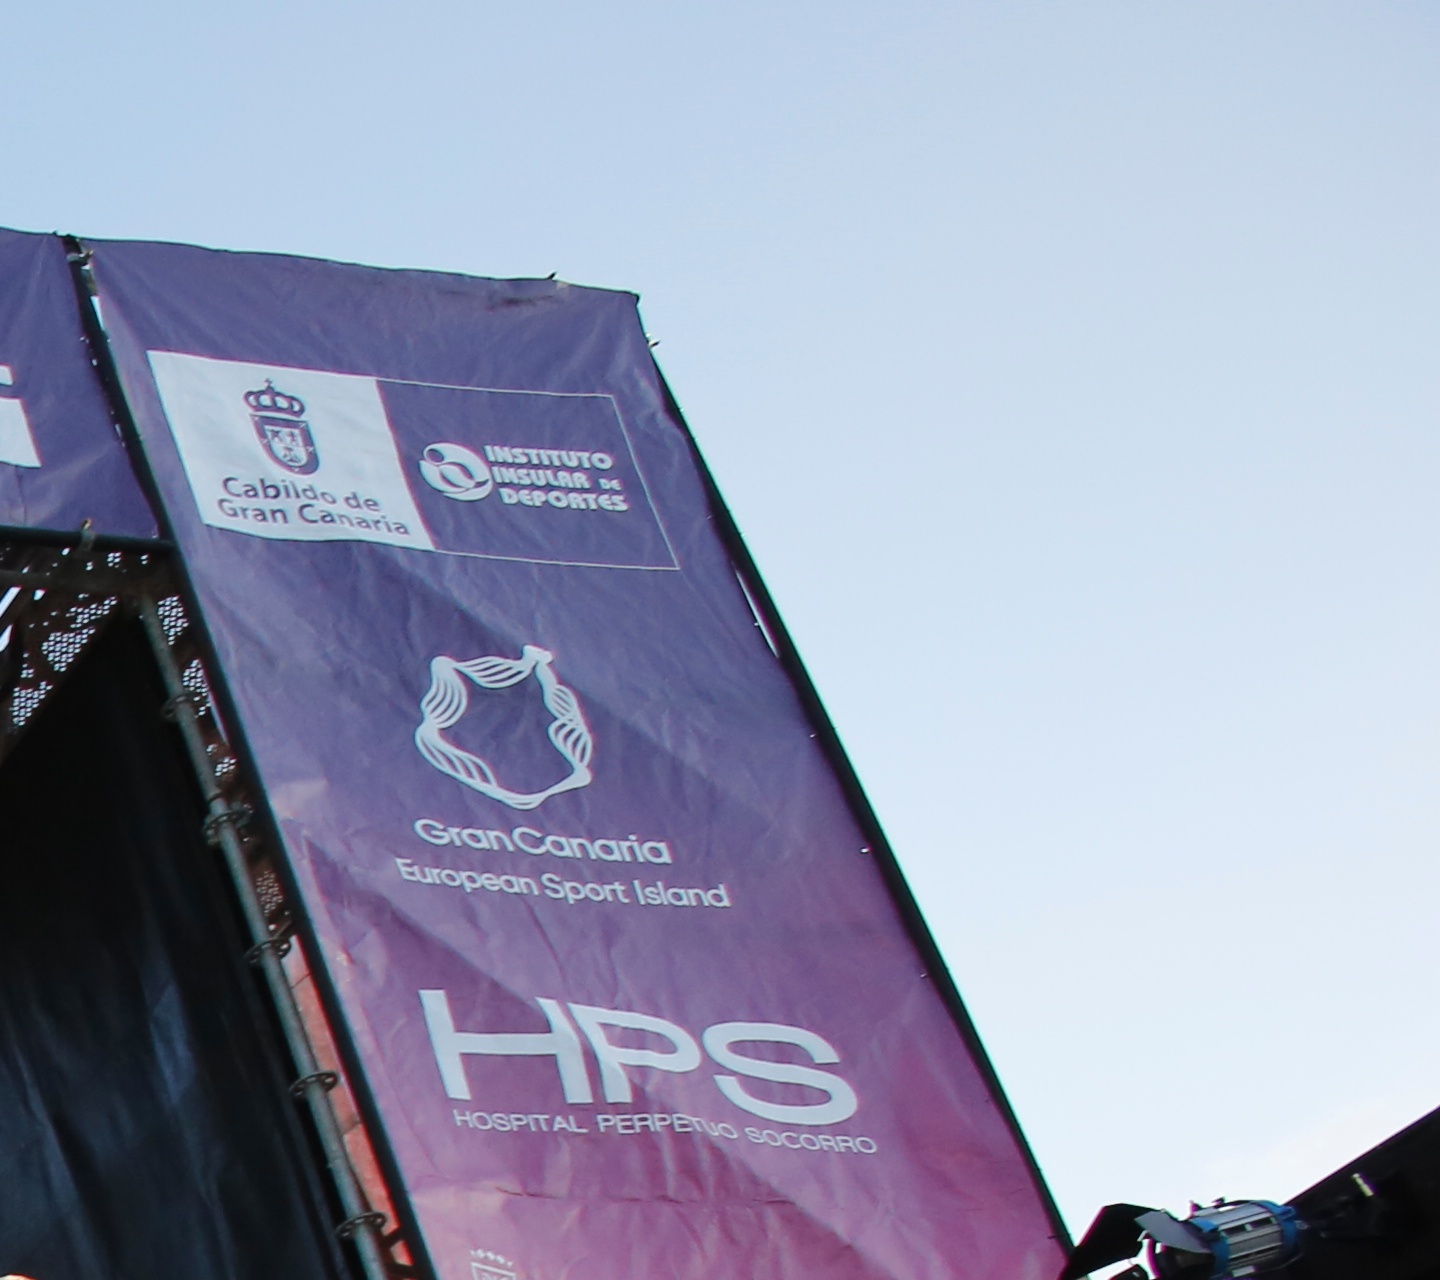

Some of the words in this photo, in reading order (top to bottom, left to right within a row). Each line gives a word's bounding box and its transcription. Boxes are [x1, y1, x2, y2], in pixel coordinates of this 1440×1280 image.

[485, 444, 613, 471] INSTITUTO
[222, 476, 337, 507] Cabildo
[342, 490, 381, 512] de
[492, 466, 589, 490] INSULAR
[600, 479, 622, 491] DE
[216, 497, 291, 525] Gran
[297, 502, 410, 537] Canaria
[502, 486, 629, 512] DEPORTES
[395, 859, 539, 900] European
[542, 873, 631, 905] Sport
[635, 878, 732, 910] Island
[419, 988, 858, 1126] HPS
[454, 1109, 588, 1135] HOSPITAL
[598, 1114, 739, 1142] PERPETUO
[745, 1125, 877, 1155] SOCORRO
